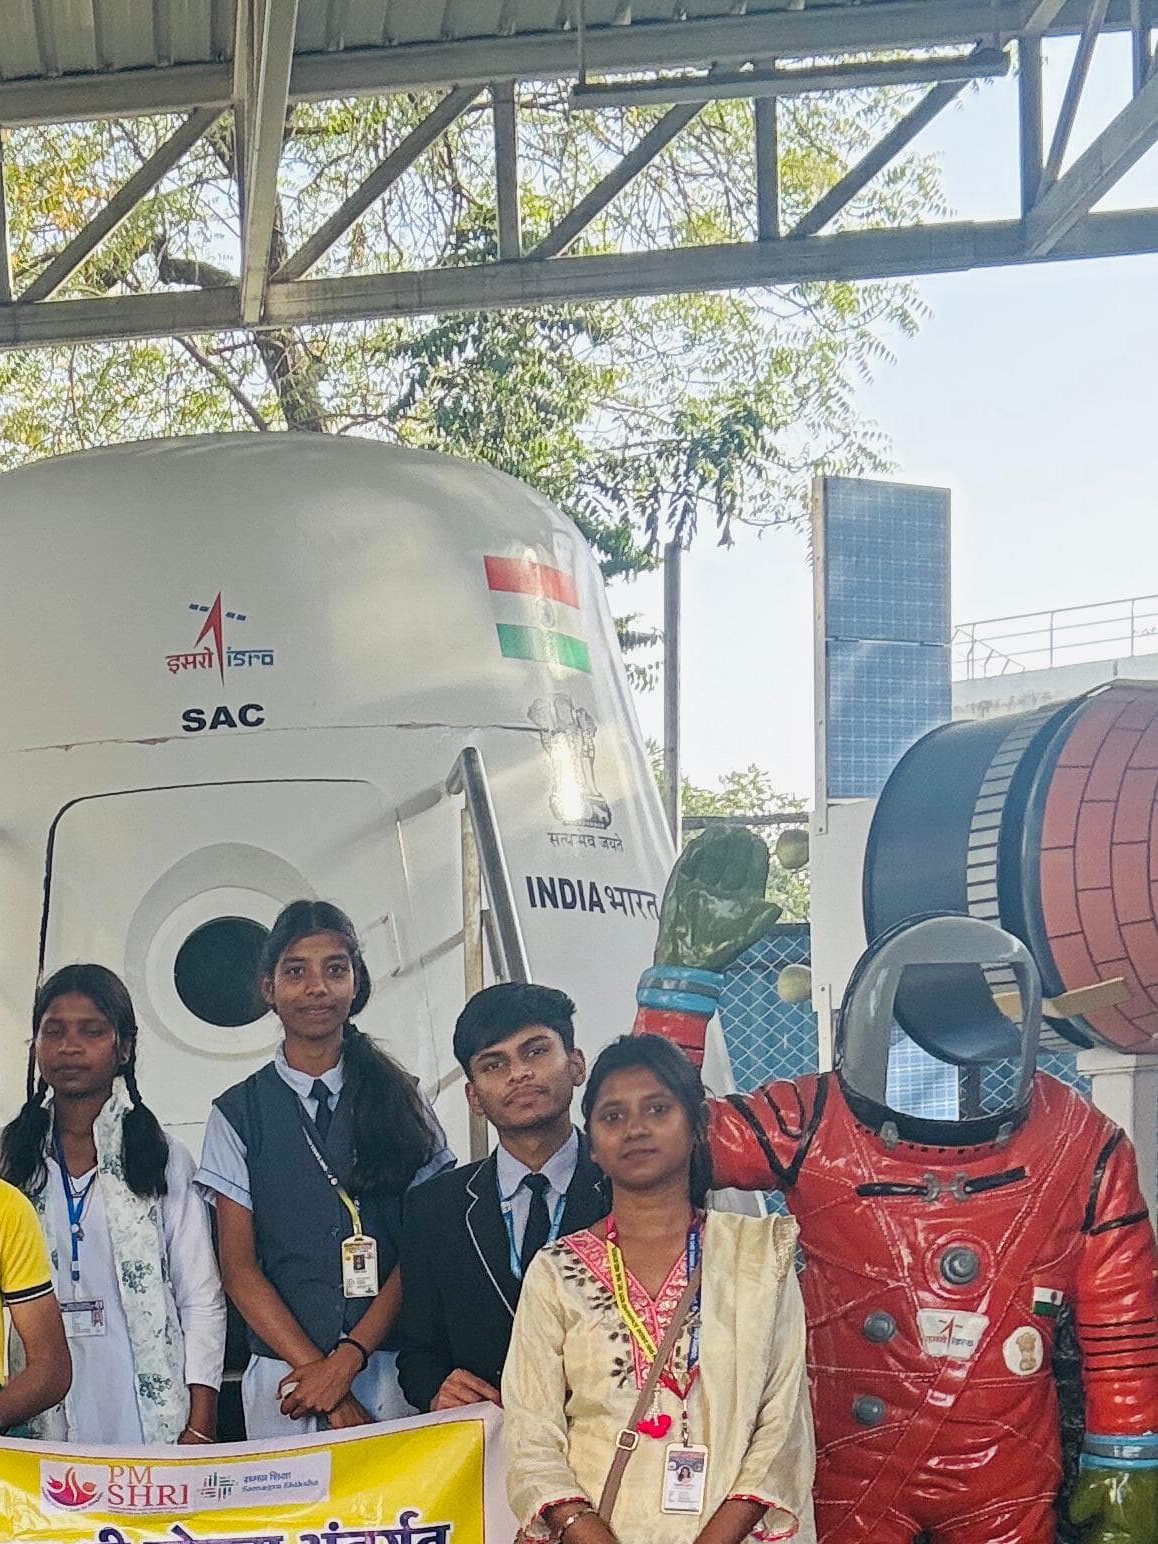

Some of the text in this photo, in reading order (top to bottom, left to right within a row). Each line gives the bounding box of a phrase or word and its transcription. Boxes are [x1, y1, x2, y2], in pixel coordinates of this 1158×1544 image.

[165, 646, 214, 674] इसरो
[226, 646, 274, 667] isro
[181, 703, 266, 732] SAC
[525, 875, 606, 914] INDIA
[604, 885, 661, 921] भारत
[108, 1465, 152, 1484] PM
[107, 1483, 189, 1507] SHRI
